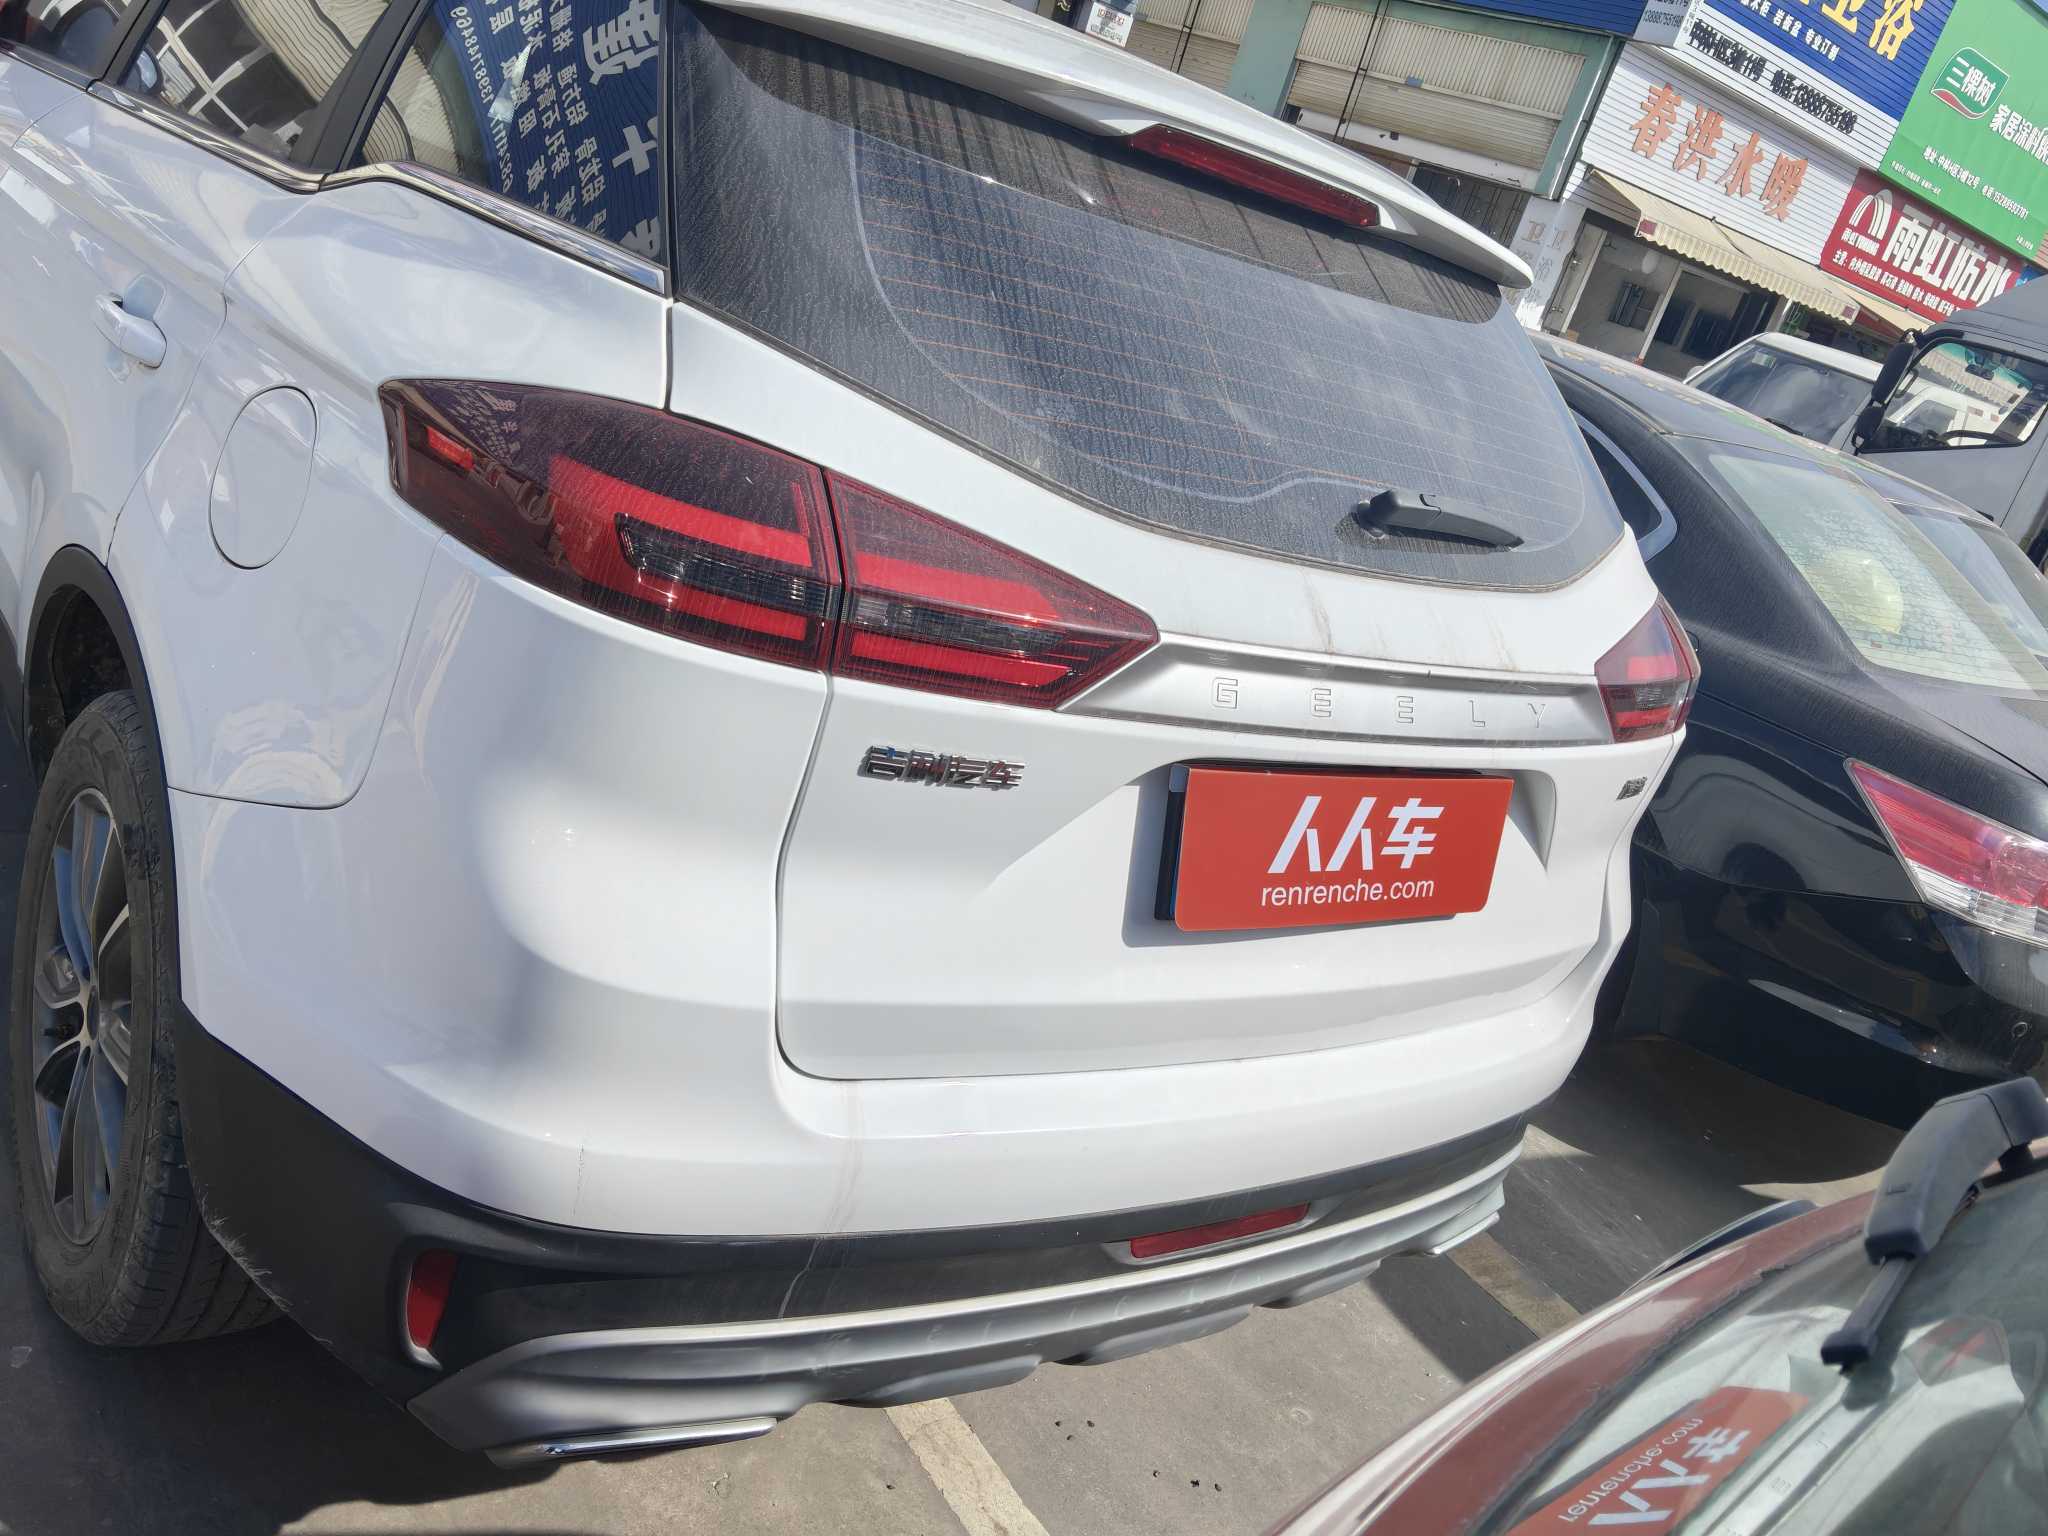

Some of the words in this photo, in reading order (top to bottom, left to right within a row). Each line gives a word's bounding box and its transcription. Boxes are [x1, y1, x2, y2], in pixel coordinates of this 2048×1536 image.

[1821, 0, 1924, 61] 卫浴
[1945, 56, 1997, 107] 三棵树
[1629, 82, 1809, 222] 春洪水暖
[1881, 204, 2013, 308] 雨虹防水
[1211, 677, 1547, 729] GEELY
[1267, 796, 1445, 873] 人人车
[1261, 878, 1435, 907] renrenche.com
